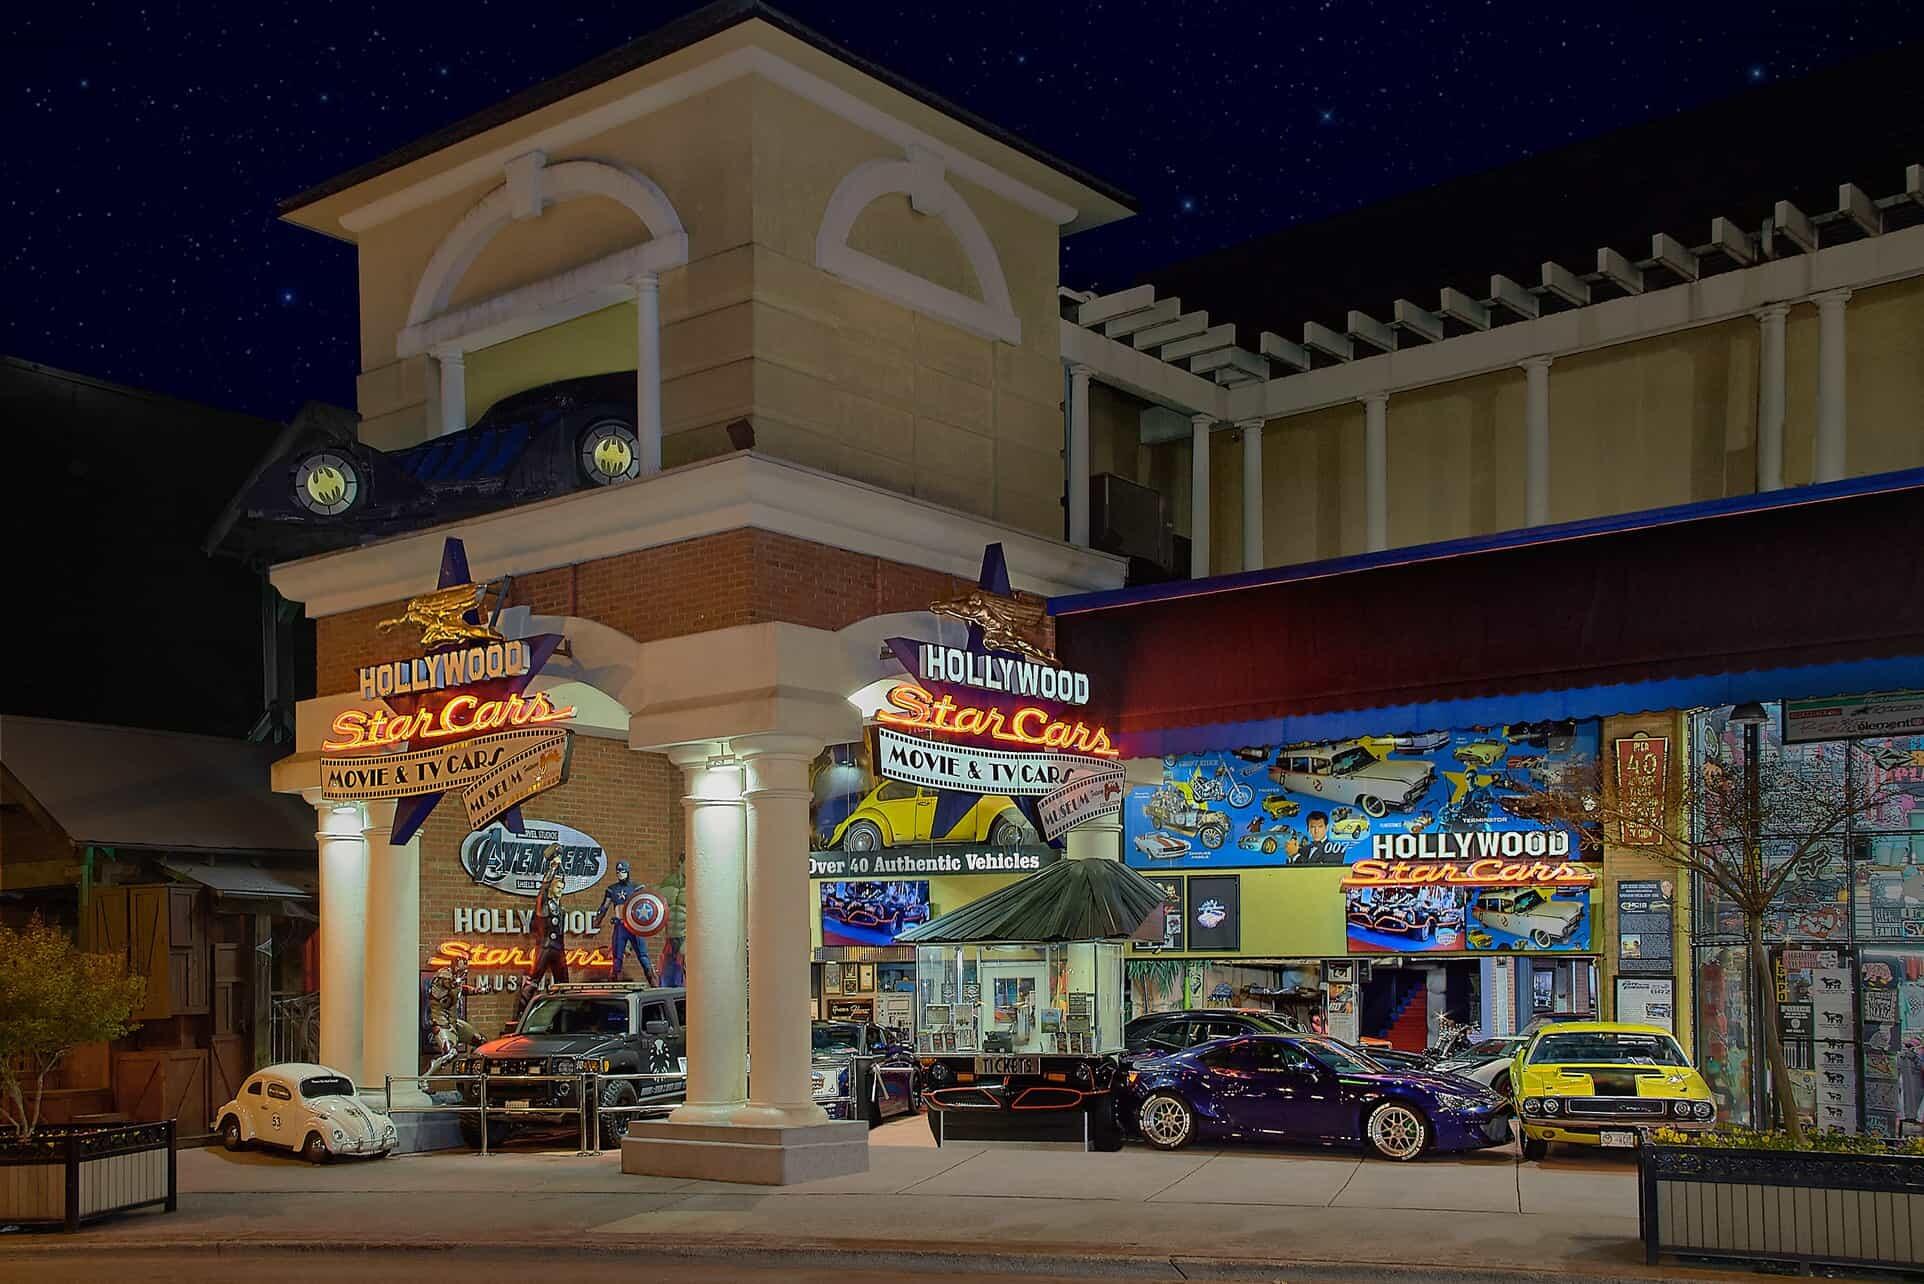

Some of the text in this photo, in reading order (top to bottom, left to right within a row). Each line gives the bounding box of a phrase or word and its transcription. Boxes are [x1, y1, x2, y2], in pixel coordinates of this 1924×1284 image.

[360, 640, 530, 700] HOLLYWOOD
[920, 644, 1089, 705] HOLLYWOOD
[322, 692, 577, 752] Star Cars
[875, 684, 1120, 757] Star Cars
[327, 766, 389, 788] MOVIE
[394, 767, 408, 784] &
[415, 758, 443, 781] TV
[446, 747, 505, 775] CARS
[888, 745, 1075, 786] MOVIE & TV CARS
[470, 769, 523, 813] MUSEUM
[1044, 791, 1090, 826] MUSEUM
[1462, 816, 1508, 825] TERMINATOR
[473, 828, 603, 883] AVENERS
[1324, 839, 1354, 854] 007
[1372, 829, 1570, 860] HOLLYWOOD
[850, 857, 869, 873] 40
[874, 856, 961, 873] Authentic
[965, 852, 1040, 872] Vehicles
[1340, 858, 1597, 885] Star Cars
[430, 941, 532, 967] Star
[982, 1056, 1033, 1073] TICKETS
[271, 1115, 282, 1128] 53
